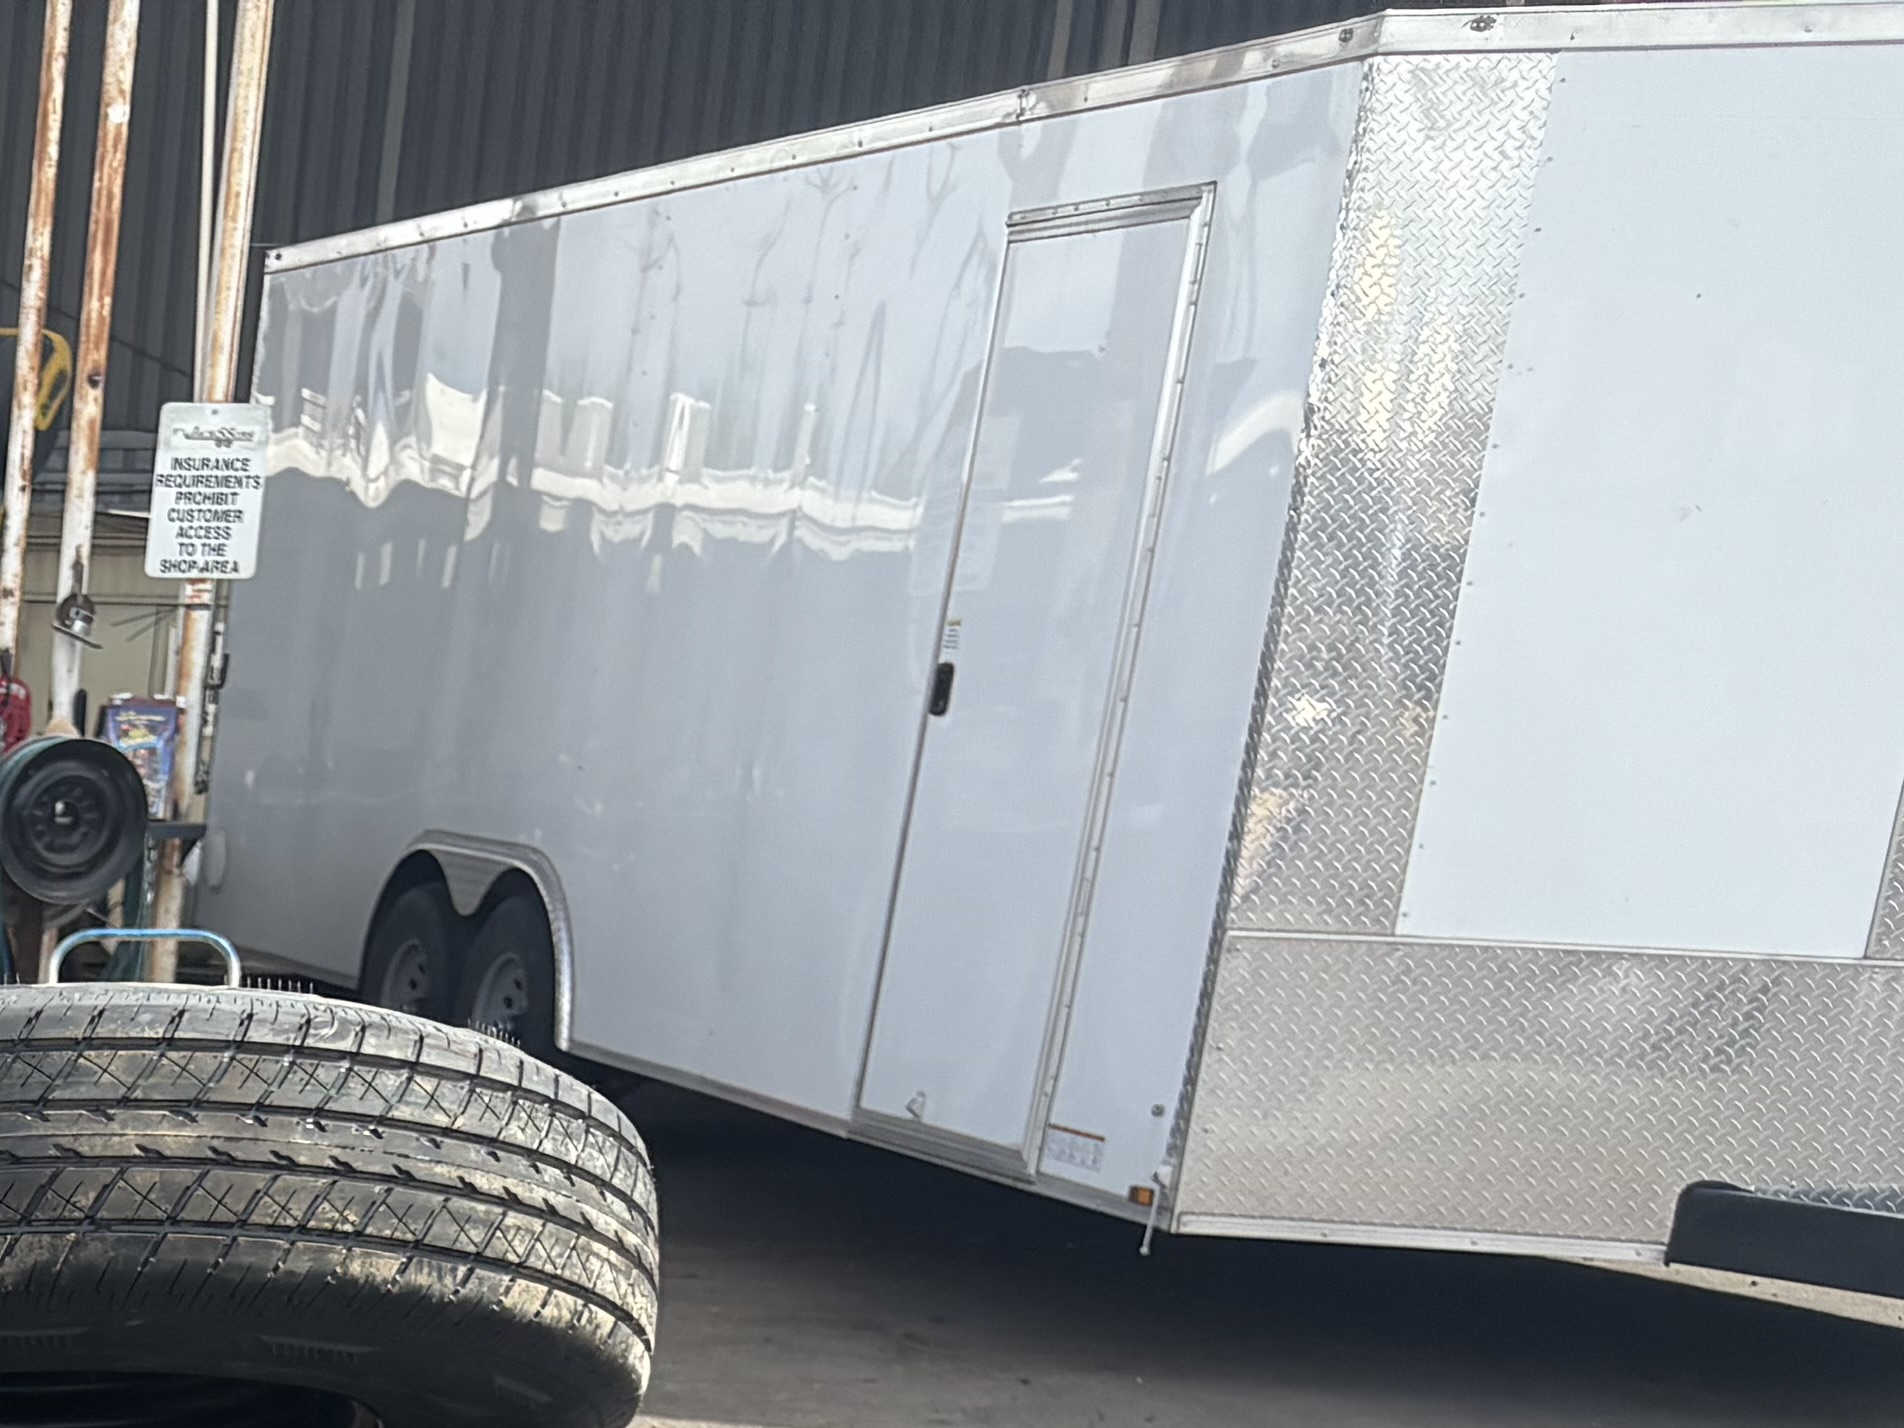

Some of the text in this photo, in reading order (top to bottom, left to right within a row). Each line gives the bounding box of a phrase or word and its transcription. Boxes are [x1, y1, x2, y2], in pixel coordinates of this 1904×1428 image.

[170, 457, 252, 473] INSURANCE
[155, 474, 263, 490] REQUIREMENTS
[174, 491, 241, 506] PROHIBIT
[167, 508, 244, 523] CUSTOMER
[175, 525, 233, 541] ACCESS
[177, 543, 228, 557] TO THE
